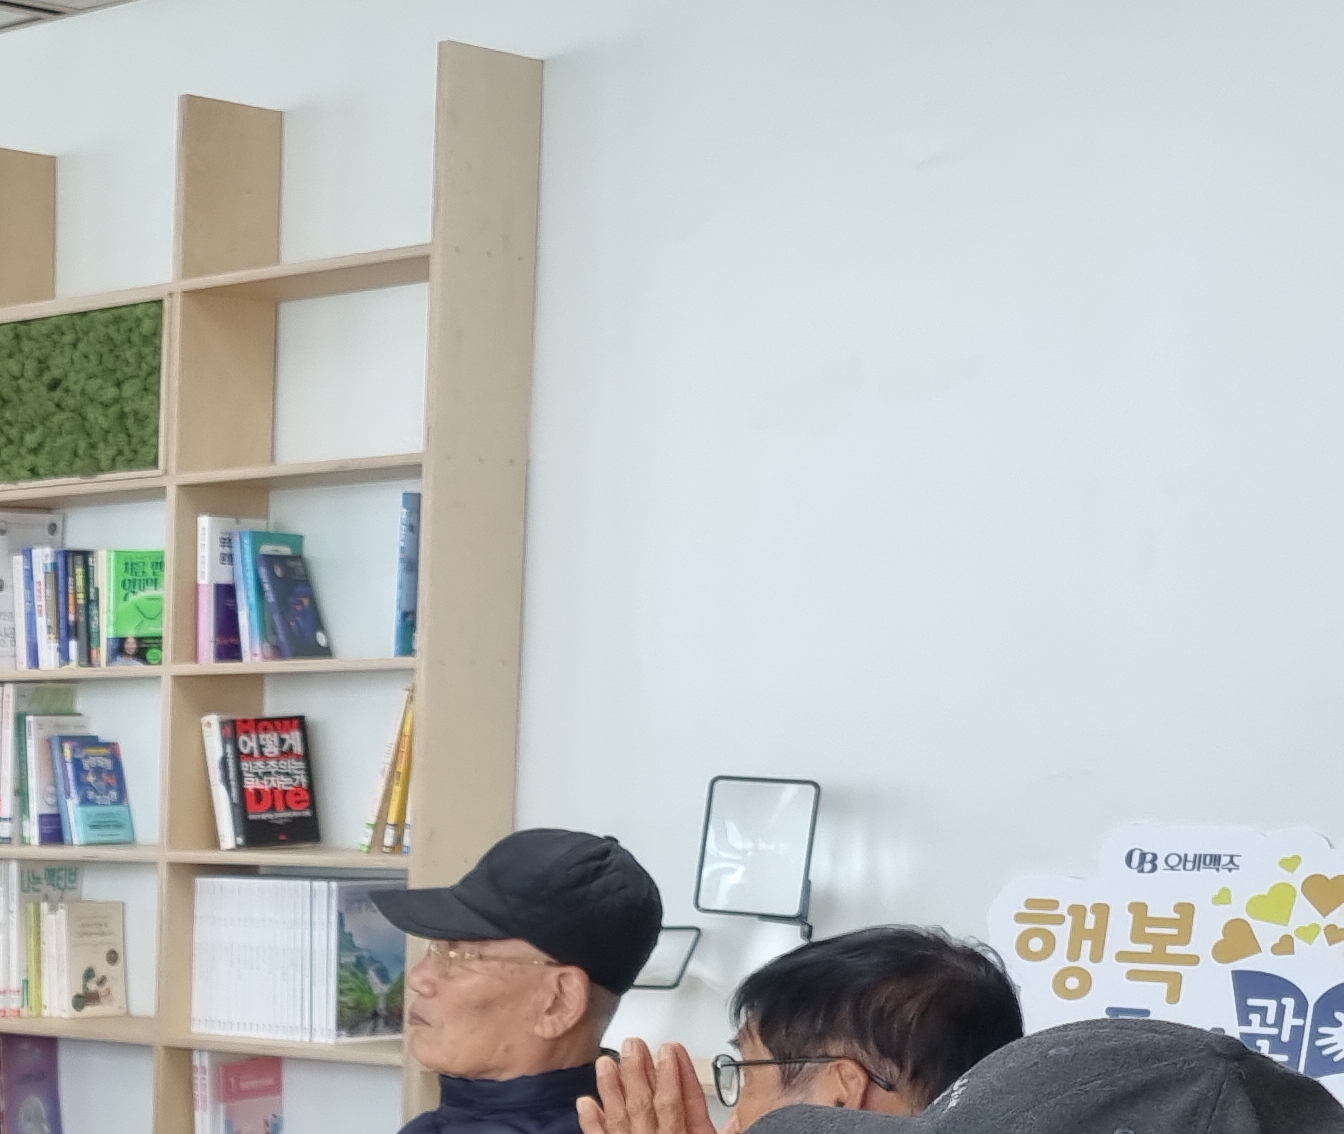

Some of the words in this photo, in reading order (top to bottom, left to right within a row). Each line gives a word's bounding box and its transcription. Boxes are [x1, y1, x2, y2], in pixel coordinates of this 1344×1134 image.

[238, 730, 304, 758] 어떻게
[243, 785, 311, 814] Die
[1124, 847, 1159, 875] OB
[1163, 852, 1243, 874] 오비맥주
[1013, 897, 1201, 1005] 행복
